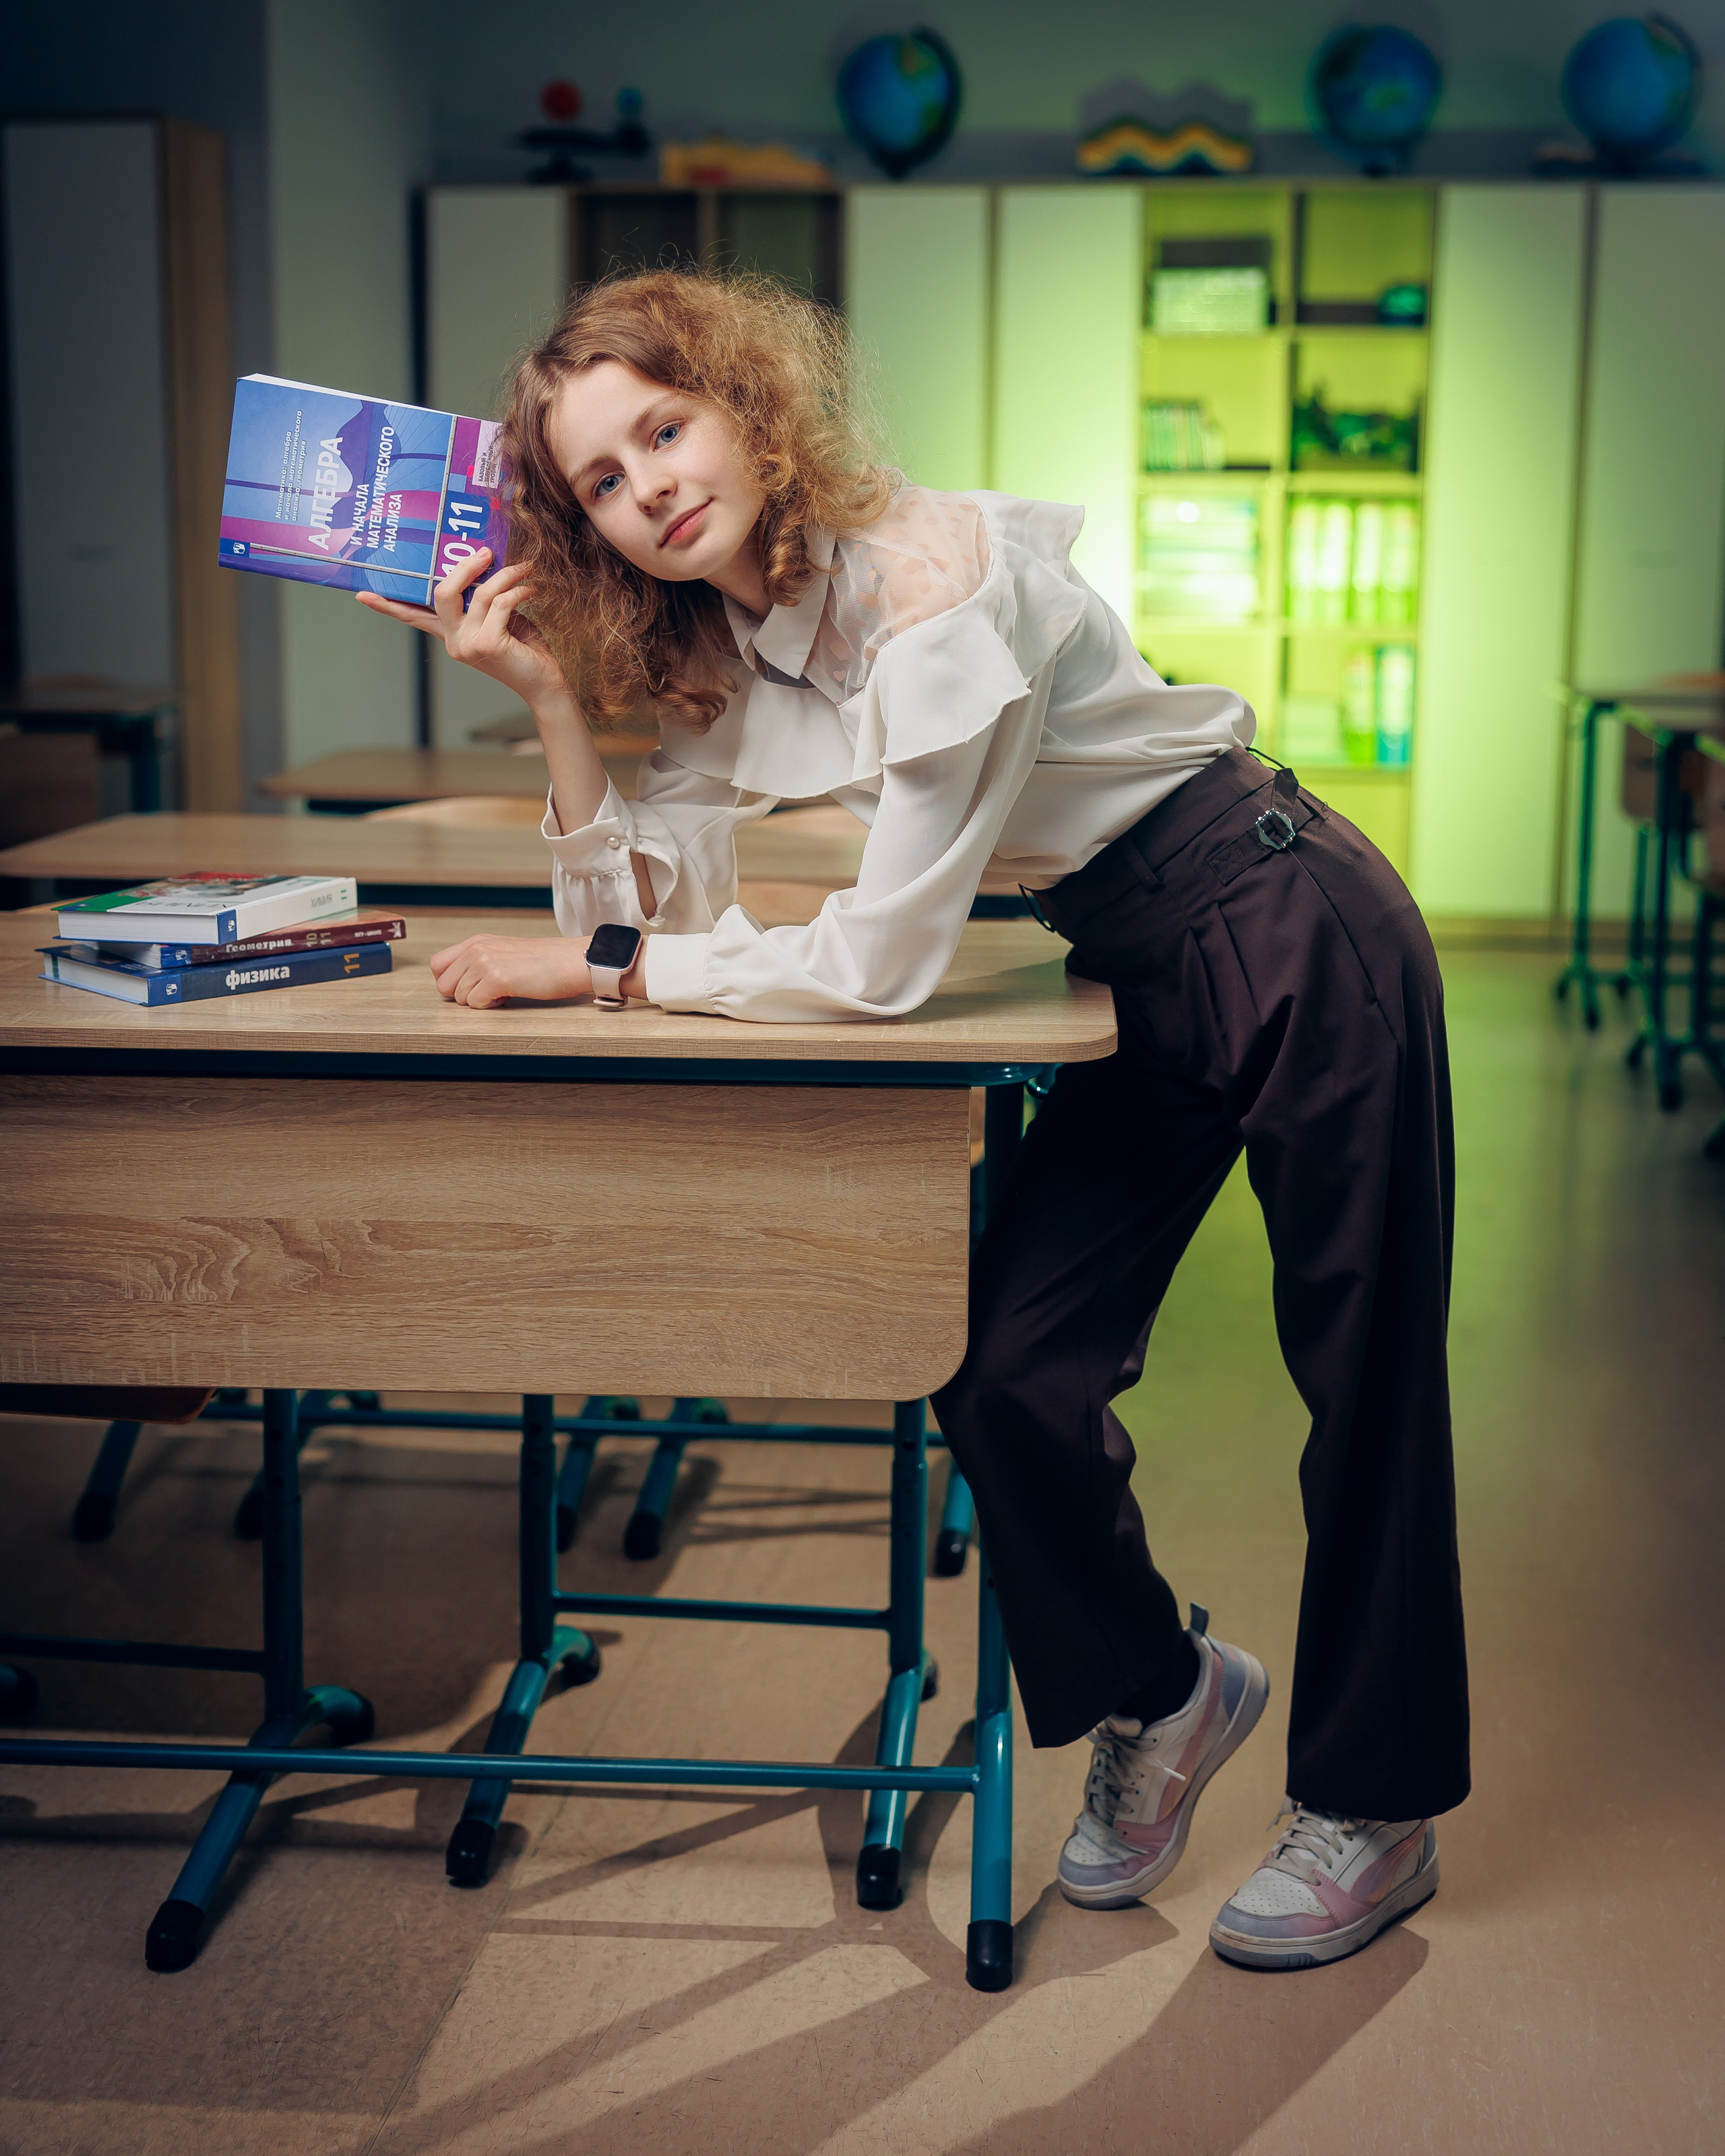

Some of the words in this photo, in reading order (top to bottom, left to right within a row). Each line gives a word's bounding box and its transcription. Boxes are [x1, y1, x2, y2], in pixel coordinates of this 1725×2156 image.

[289, 410, 303, 481] математического
[275, 466, 288, 519] Математика:
[283, 430, 292, 465] алгебра
[292, 485, 302, 521] анализа,
[297, 440, 307, 482] геометрия
[309, 437, 343, 551] АЛГЕБРА
[366, 425, 395, 549] МАТЕМАТИЧЕСКОГО
[352, 484, 369, 532] НАЧАЛА
[383, 494, 403, 552] АНАЛИЗА
[350, 534, 363, 546] И
[225, 938, 292, 953] Геометрия
[305, 932, 317, 947] 10
[319, 932, 331, 945] 11
[225, 965, 290, 990] физика
[344, 952, 360, 974] 11
